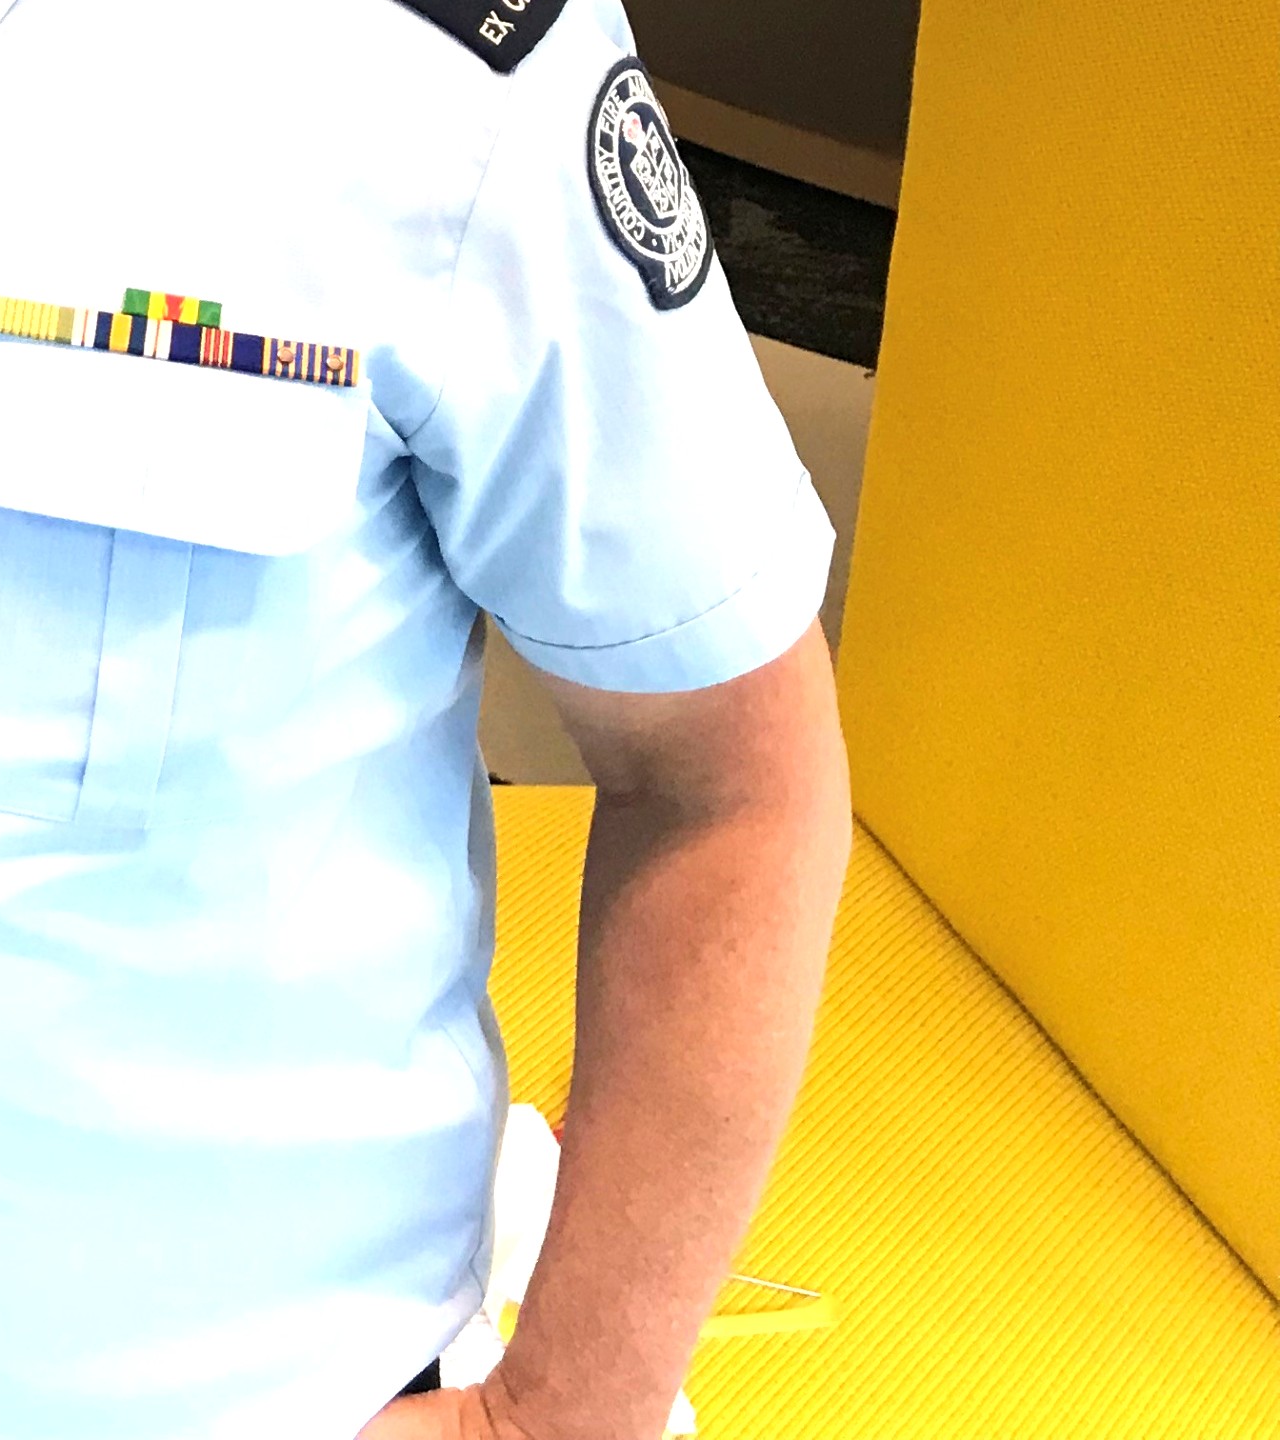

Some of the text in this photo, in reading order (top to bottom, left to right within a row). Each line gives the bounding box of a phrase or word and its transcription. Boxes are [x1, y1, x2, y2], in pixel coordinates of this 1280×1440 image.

[478, 9, 515, 46] EX
[596, 87, 646, 242] COUNTRY FIRE
